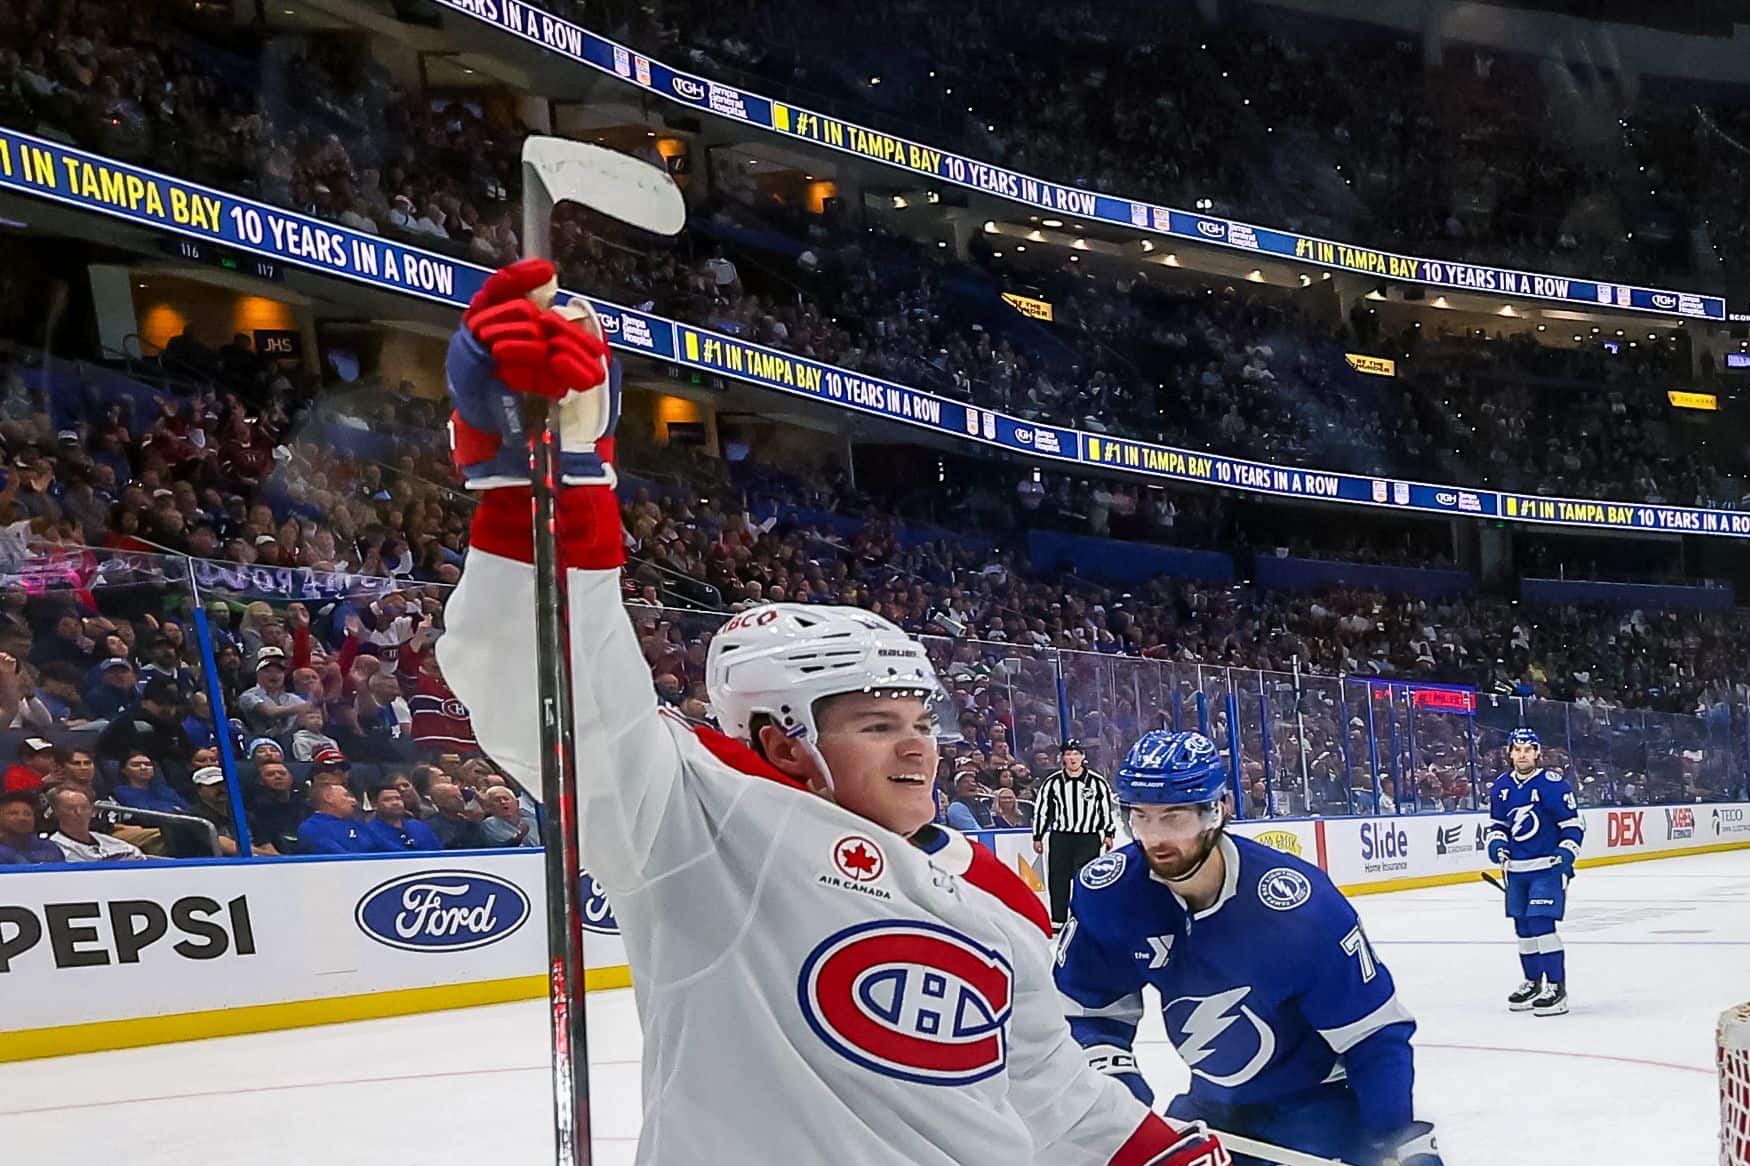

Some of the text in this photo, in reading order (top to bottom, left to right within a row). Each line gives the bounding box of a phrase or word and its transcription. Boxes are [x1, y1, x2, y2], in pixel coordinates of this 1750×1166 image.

[502, 0, 522, 32] IN
[528, 12, 539, 38] A
[543, 15, 582, 57] ROW
[798, 112, 1097, 216] #1 IN TAMPA BAY 10 YEARS IN A ROW
[0, 139, 454, 296] 1 IN TAMPA BAY 10 YEARS IN A ROW
[1296, 239, 1569, 298] #1 IN TAMPA BAY 10 YEARS IN A ROW
[704, 338, 723, 363] #1
[726, 343, 743, 369] IN
[745, 349, 793, 383] TAMPA
[796, 364, 822, 392] BAY
[826, 373, 842, 397] 10
[844, 377, 885, 409] YEARS
[887, 390, 902, 412] IN
[903, 395, 914, 416] A
[915, 397, 941, 424] ROW
[1531, 789, 1539, 801] A
[1360, 822, 1408, 861] Slide
[1607, 811, 1645, 847] DEX
[819, 875, 891, 900] AIR CANADA
[1365, 862, 1408, 873] Home Insurance
[0, 894, 257, 974] PEPSI
[395, 884, 497, 938] Ford
[1134, 952, 1150, 960] the
